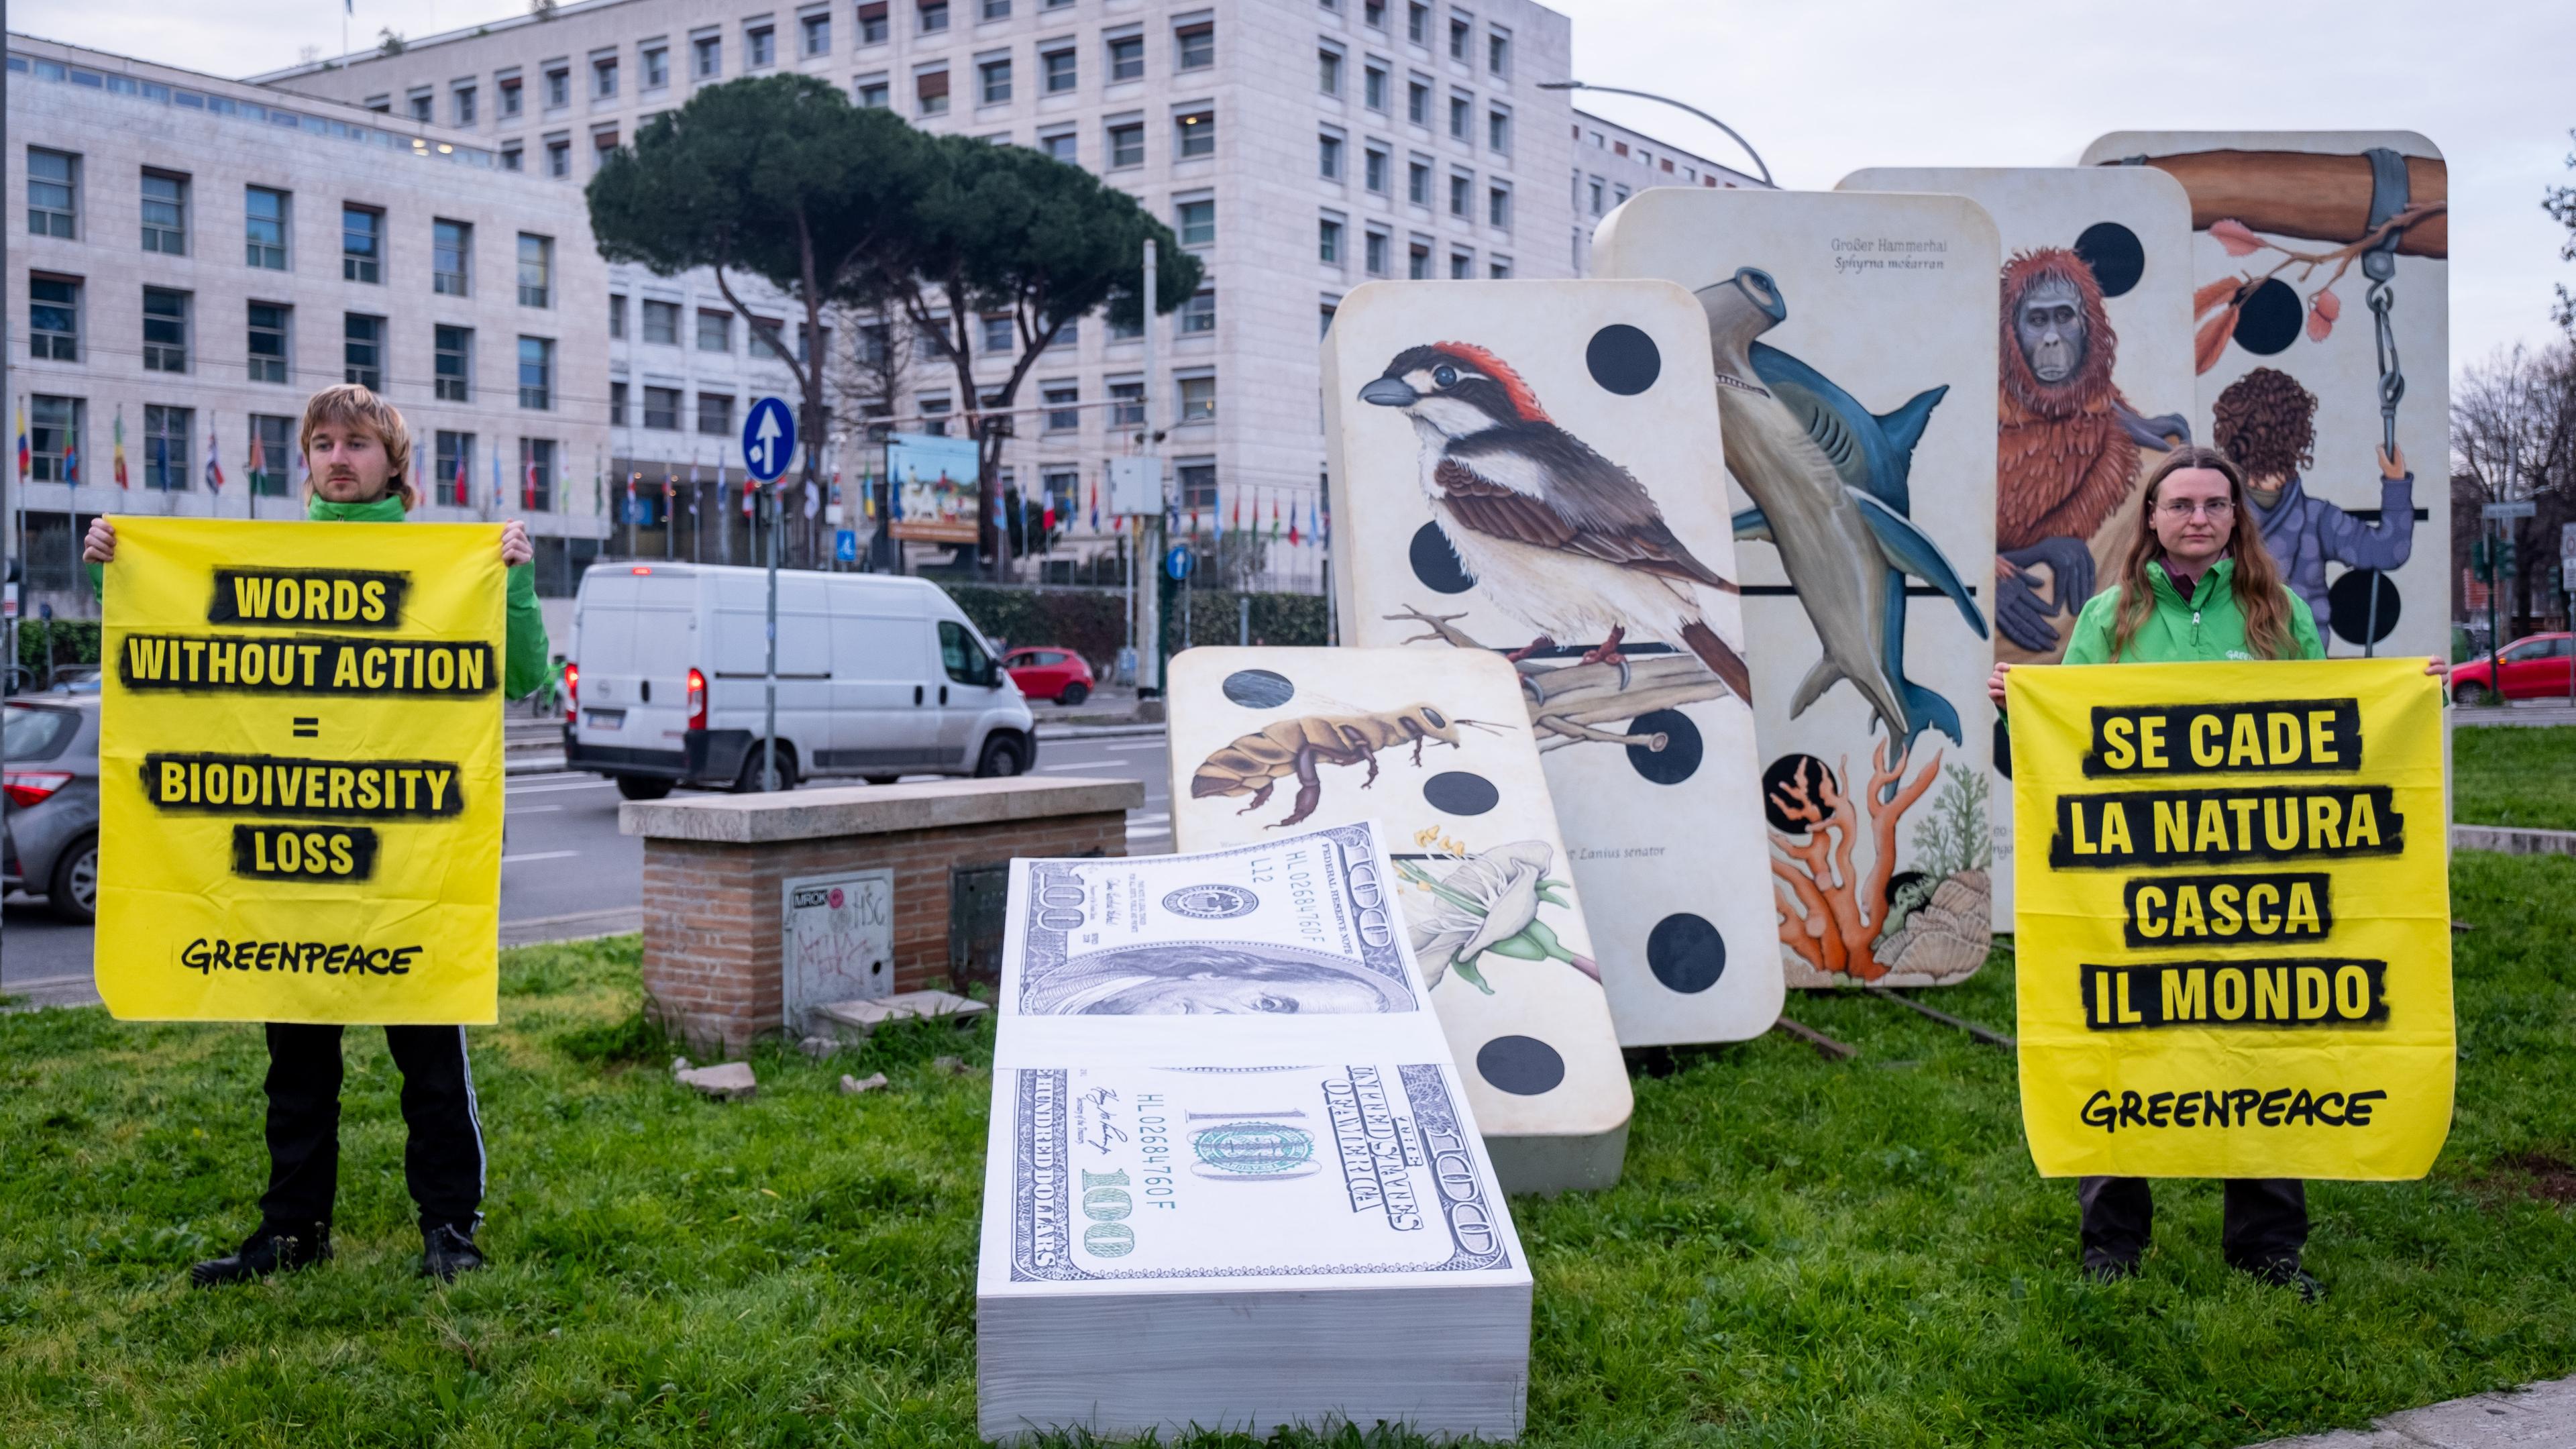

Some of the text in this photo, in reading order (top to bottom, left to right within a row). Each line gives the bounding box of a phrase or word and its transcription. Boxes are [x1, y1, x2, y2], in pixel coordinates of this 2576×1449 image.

[1831, 237, 1874, 252] Großer
[1834, 254, 1884, 274] Sphyrna
[234, 577, 386, 622] WORDS
[129, 638, 484, 690] WITHOUT ACTION
[2226, 650, 2254, 660] GREEN
[2103, 710, 2339, 771] SE CADE
[160, 761, 451, 810] BIODIVERSITY
[254, 830, 354, 874] LOSS
[1579, 847, 1620, 860] Lanius
[1624, 847, 1666, 857] senator
[2070, 794, 2380, 855] LA NATURA
[1251, 858, 1274, 883] L12
[1322, 843, 1353, 954] FEDERAL RESERVE NOTE
[1342, 843, 1392, 947] 100
[1036, 873, 1085, 932] 100
[2135, 881, 2320, 939] CASCA
[181, 939, 423, 975] GREENPEACE
[2096, 965, 2370, 1024] IL MONDO
[1034, 1077, 1054, 1167] HUNDRED
[2080, 1088, 2387, 1133] GREENPEACE
[1328, 1107, 1384, 1213] AMERICA
[1367, 1140, 1424, 1232] STATES
[1034, 1169, 1057, 1267] DOLLARS
[1082, 1168, 1134, 1258] 100
[1418, 1128, 1499, 1255] 100
